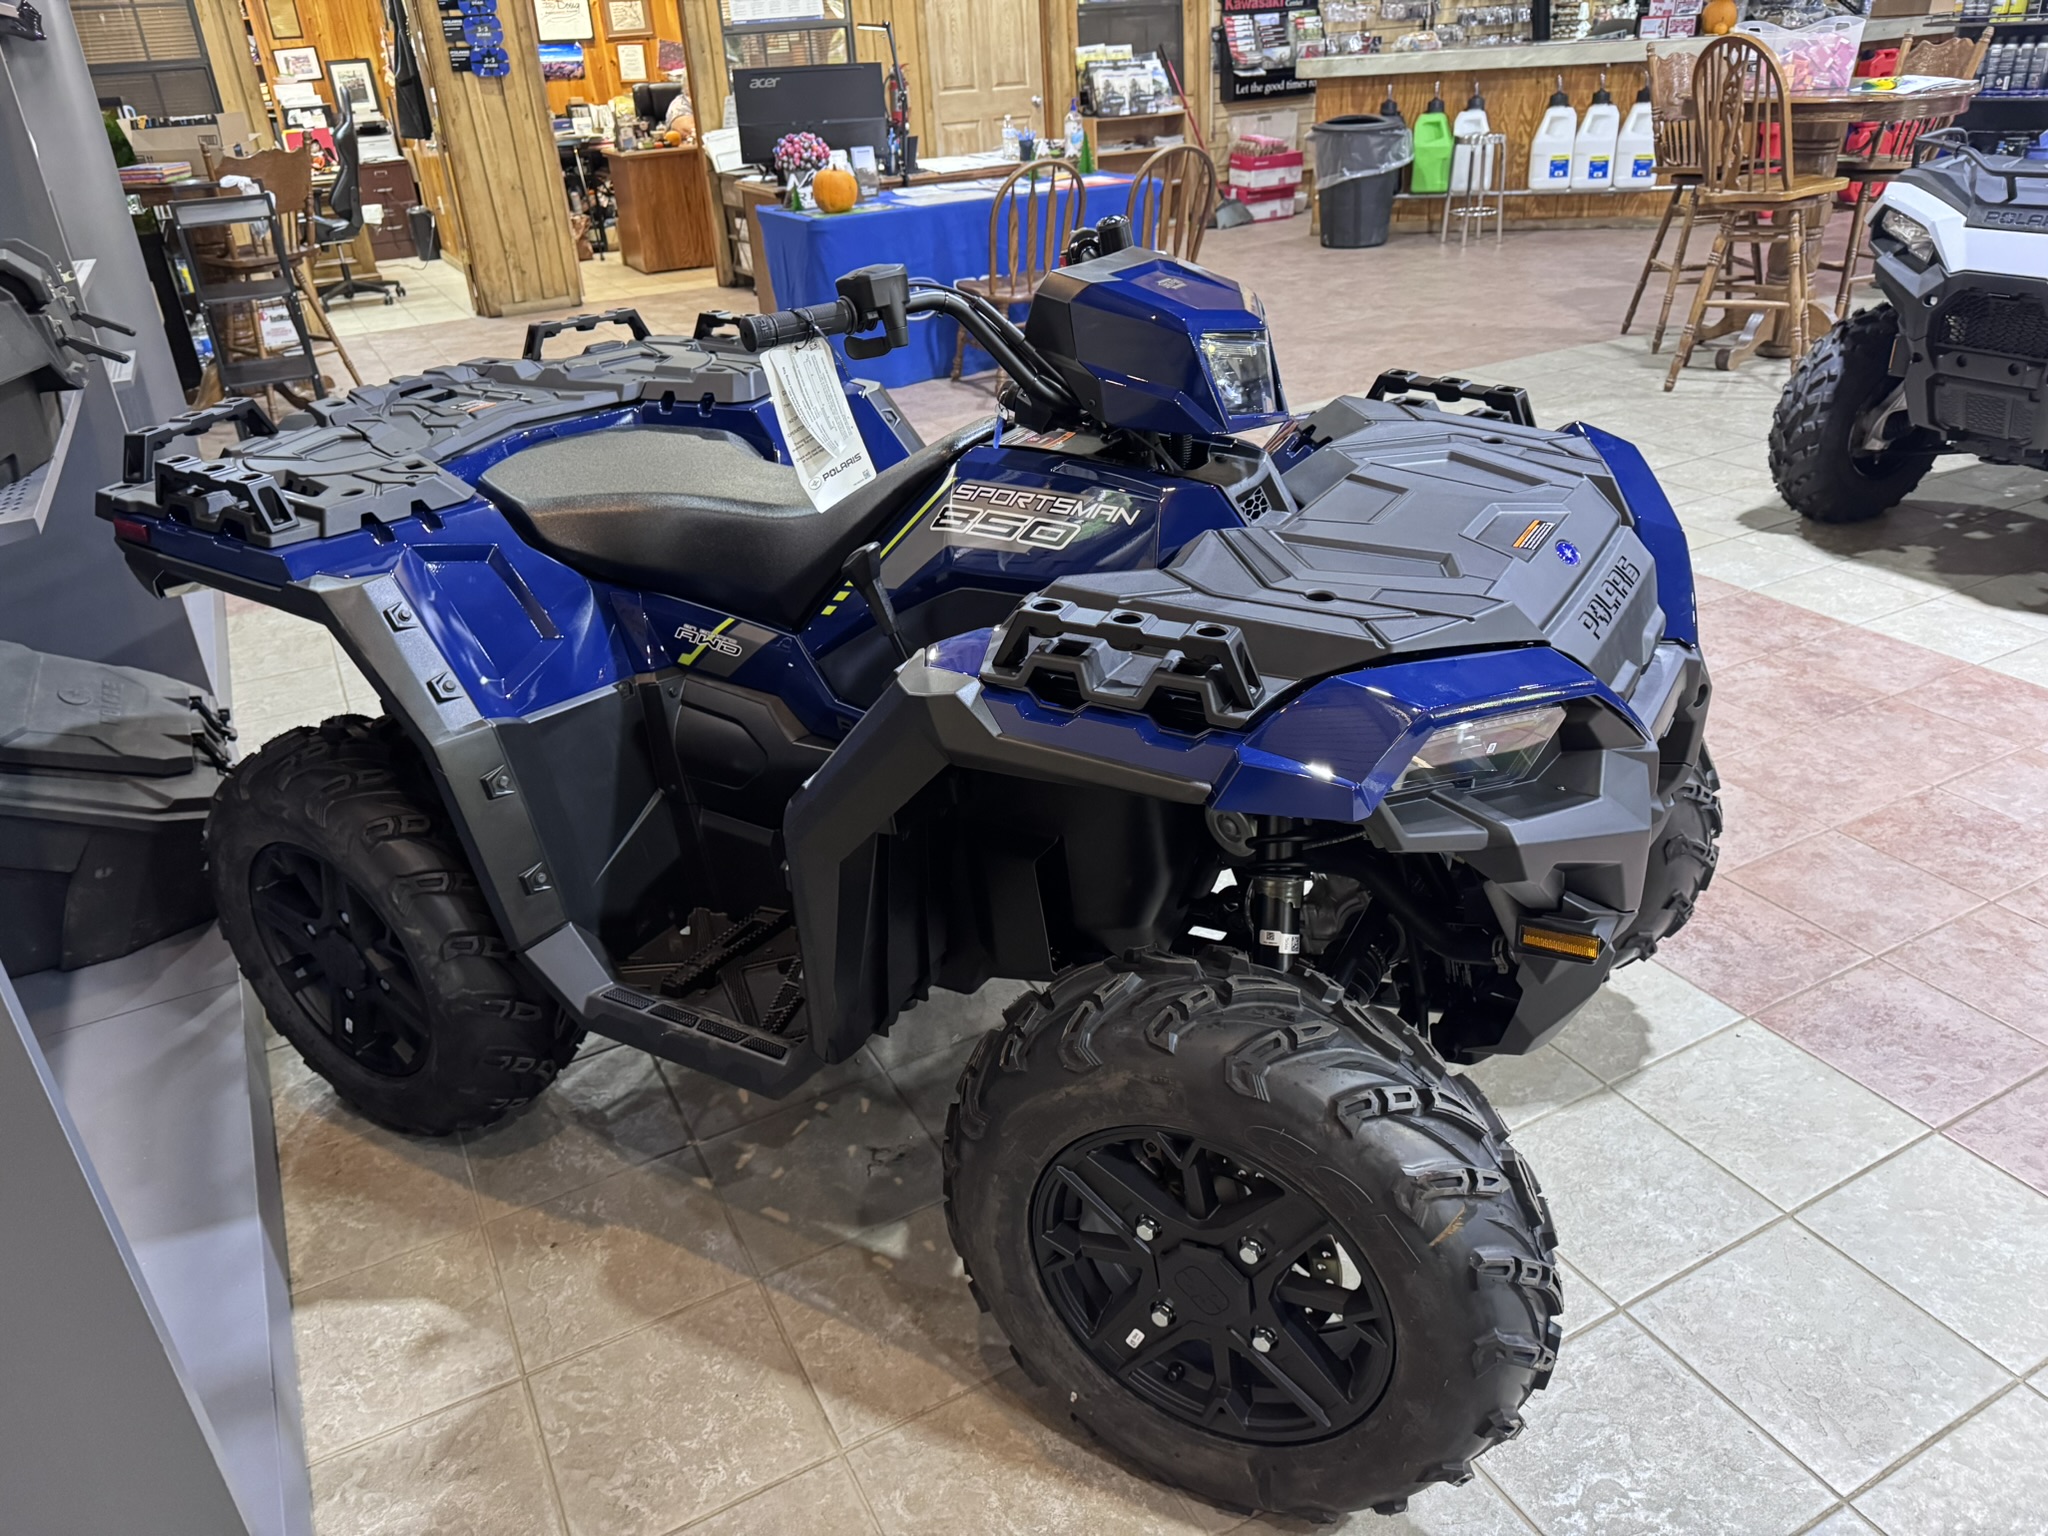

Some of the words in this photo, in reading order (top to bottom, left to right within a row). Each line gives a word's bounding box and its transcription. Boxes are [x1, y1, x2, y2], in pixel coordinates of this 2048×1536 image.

[749, 77, 781, 89] acer
[1236, 83, 1249, 95] Let
[1250, 81, 1263, 93] the
[1264, 80, 1285, 95] good
[1286, 79, 1307, 90] times
[822, 452, 862, 481] POLARIS
[952, 482, 1143, 529] SPORTSMAN
[930, 503, 1082, 551] 850
[1577, 555, 1641, 641] POLARIS
[674, 626, 743, 657] AWD
